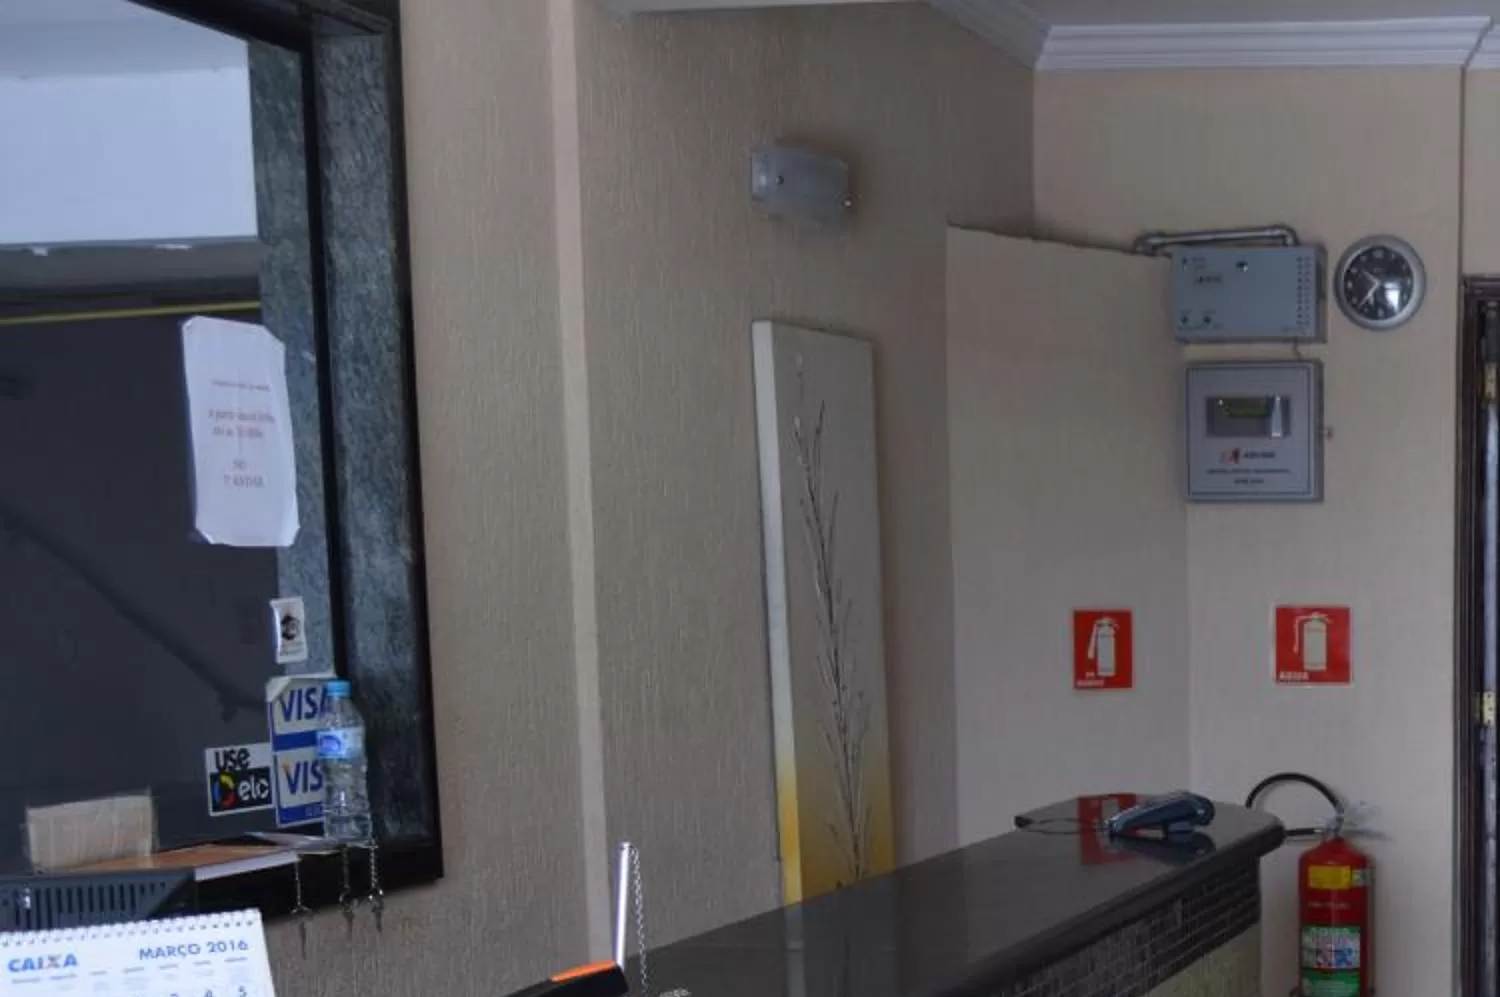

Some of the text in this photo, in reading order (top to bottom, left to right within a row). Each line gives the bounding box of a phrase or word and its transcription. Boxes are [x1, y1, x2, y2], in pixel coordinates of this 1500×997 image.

[283, 759, 323, 795] VIS
[139, 940, 249, 960] MARÇO 2016
[8, 953, 78, 973] CAIXA
[237, 986, 248, 997] 5
